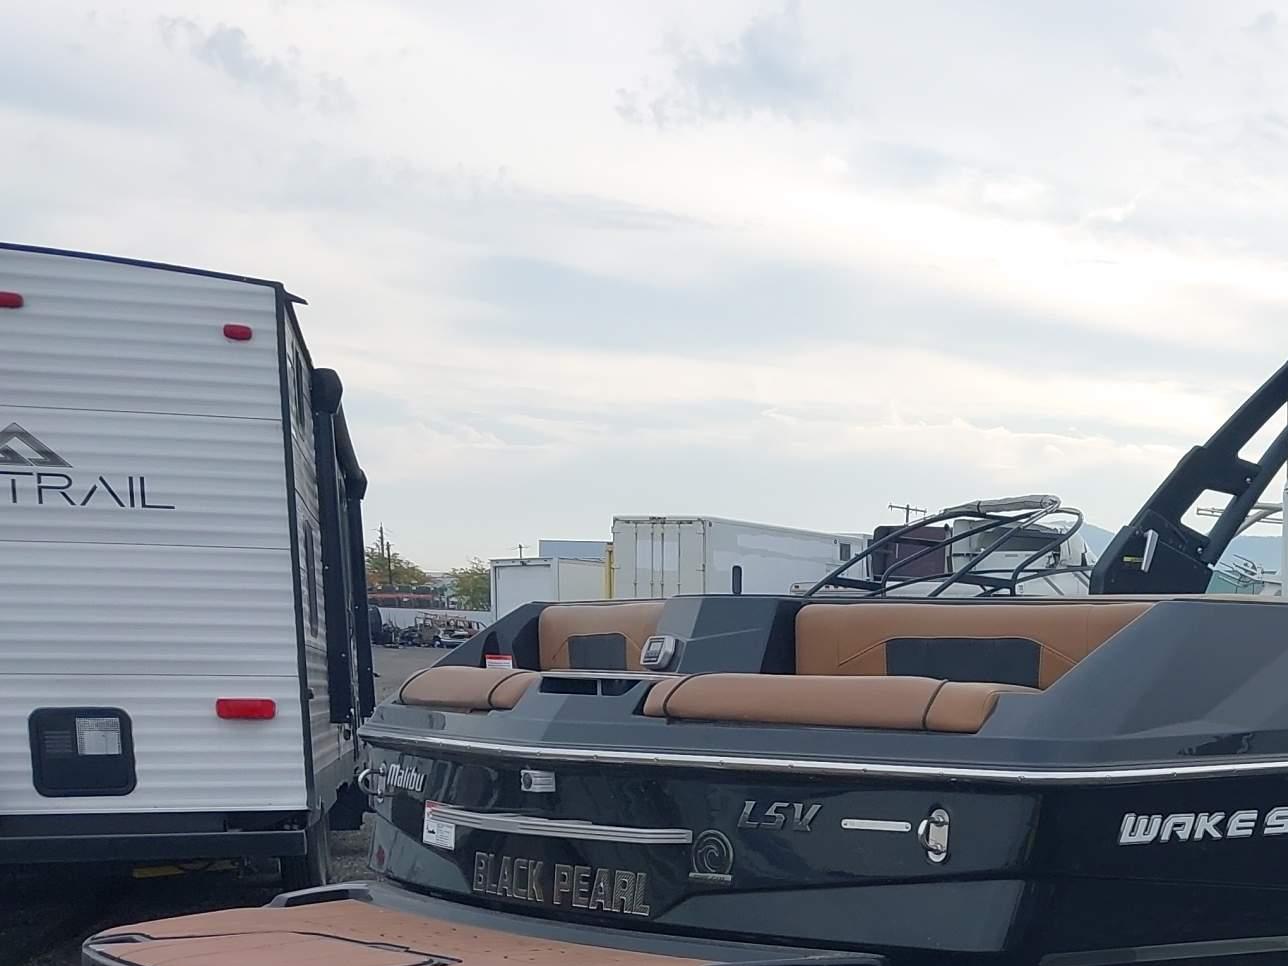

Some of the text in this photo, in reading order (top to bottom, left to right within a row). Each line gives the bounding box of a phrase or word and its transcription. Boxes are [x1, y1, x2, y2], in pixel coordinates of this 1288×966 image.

[386, 764, 425, 792] Malibu
[737, 800, 822, 832] LSV
[473, 851, 650, 917] BLACK PEARL
